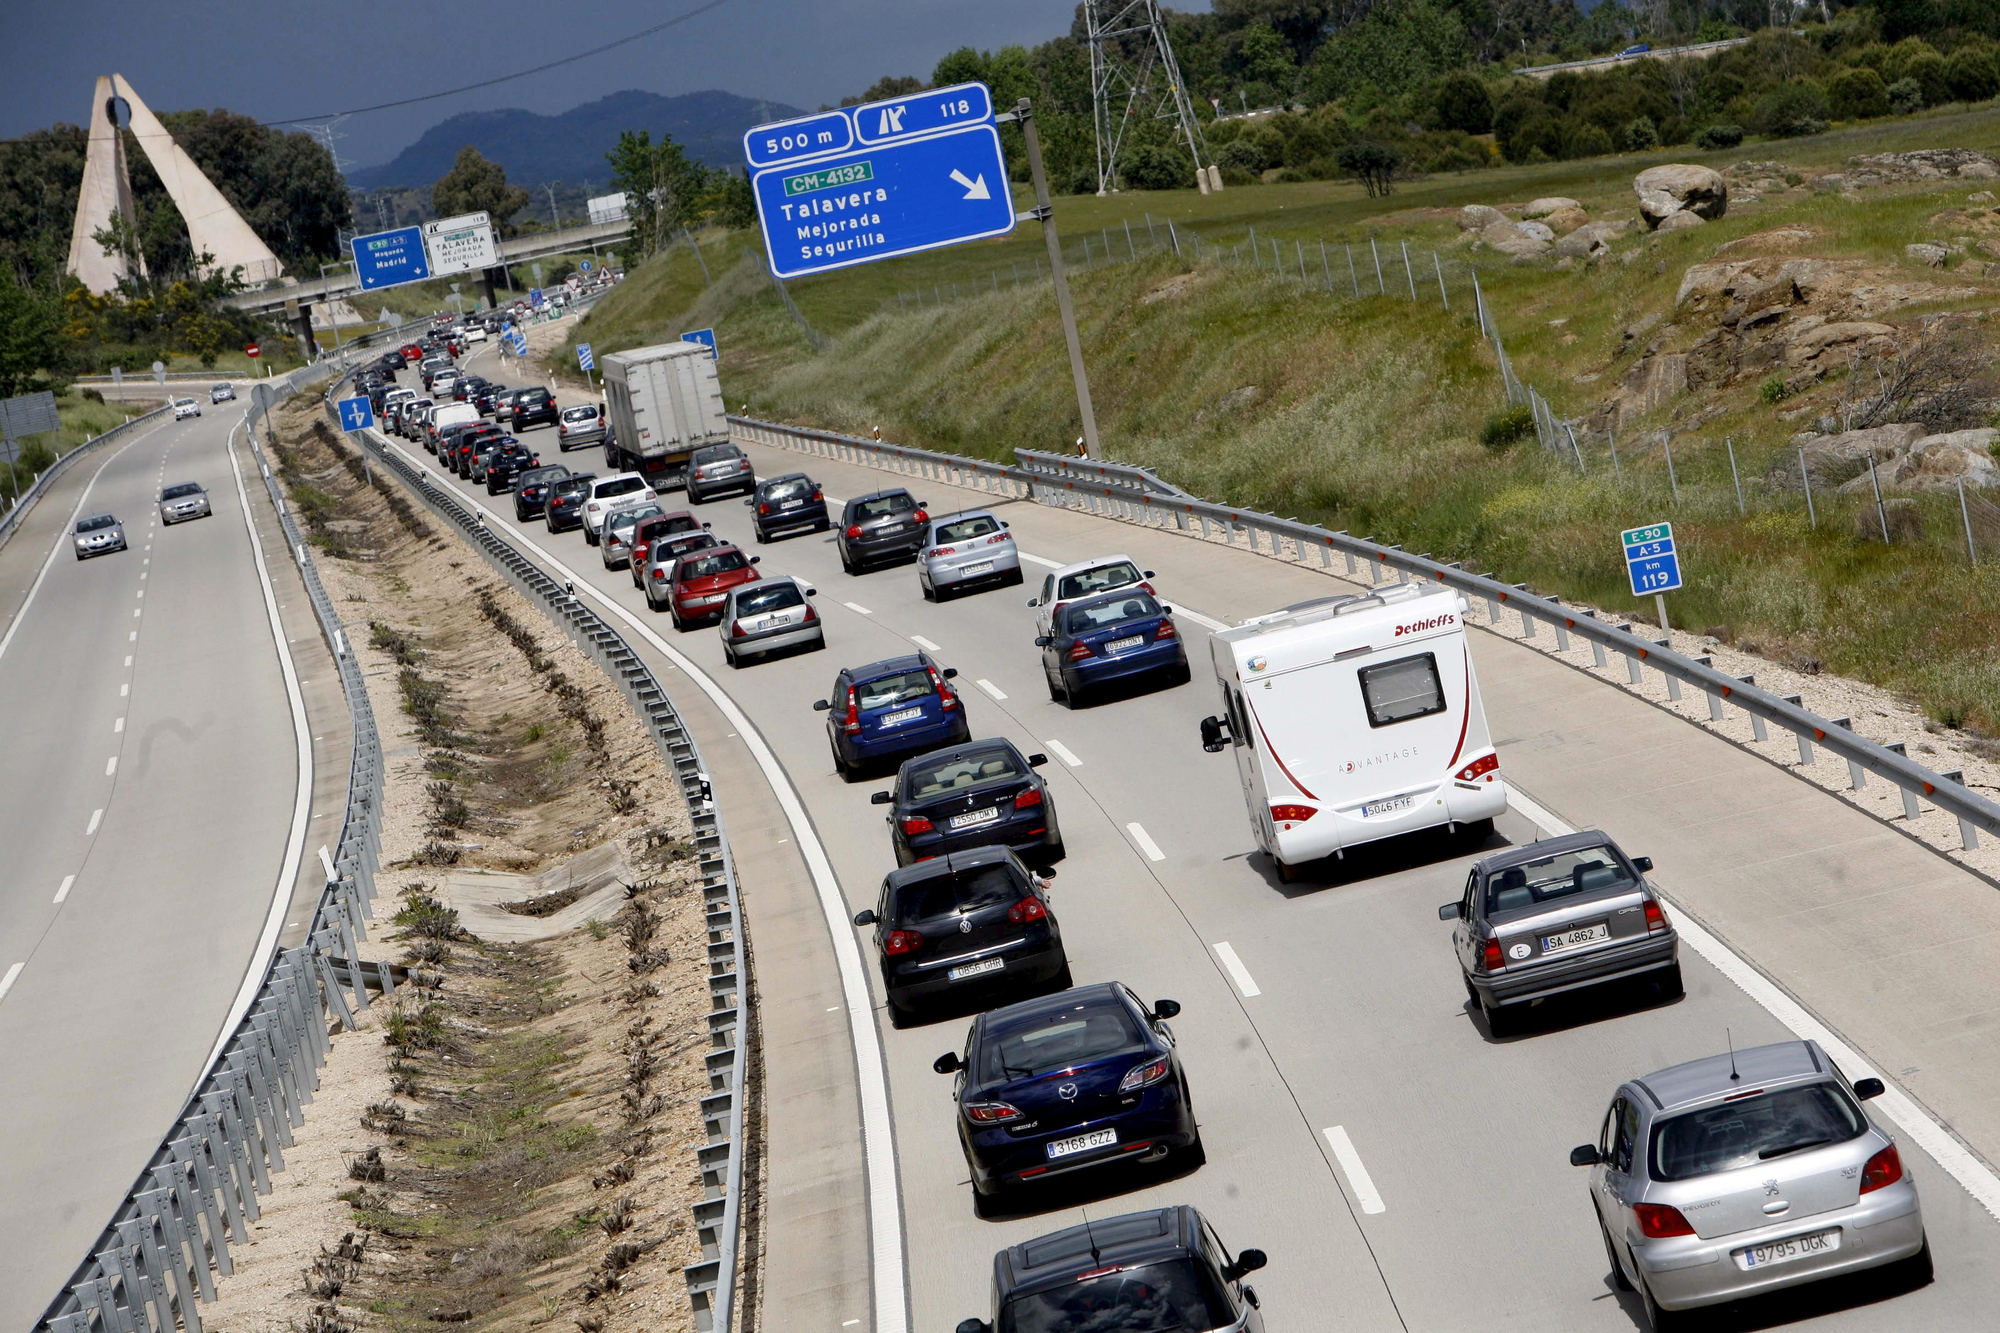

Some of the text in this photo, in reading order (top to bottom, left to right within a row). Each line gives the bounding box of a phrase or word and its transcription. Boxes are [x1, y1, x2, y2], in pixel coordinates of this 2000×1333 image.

[940, 99, 970, 118] 118
[767, 130, 833, 154] 500 m
[791, 164, 867, 193] CM-4132
[780, 187, 888, 221] Talavera
[797, 212, 881, 240] Mejorada
[436, 235, 486, 251] TALAVERA
[442, 244, 482, 257] MEJORADA
[801, 231, 886, 260] Segurilla
[376, 256, 407, 269] Madrid
[443, 251, 485, 264] SEGURILLA
[1631, 528, 1661, 543] E-90
[1640, 543, 1661, 557] A-5
[1645, 562, 1661, 571] km
[1642, 571, 1669, 589] 119
[1395, 613, 1455, 637] Dethleffs
[886, 707, 919, 722] 3707 FJY
[1338, 746, 1419, 775] ADVANTAGE
[1367, 796, 1412, 816] 5046 FYF
[956, 807, 995, 825] 2550 DMY
[1618, 905, 1641, 915] OPEL
[1549, 925, 1607, 949] SA 4862 J
[1516, 946, 1525, 958] E
[958, 957, 1002, 977] 0856 GHR
[1057, 1130, 1112, 1154] 3168 GZZ
[1840, 1166, 1859, 1177] 307
[1683, 1199, 1722, 1213] PEUGEOT
[1755, 1232, 1829, 1263] 9795 DGK
